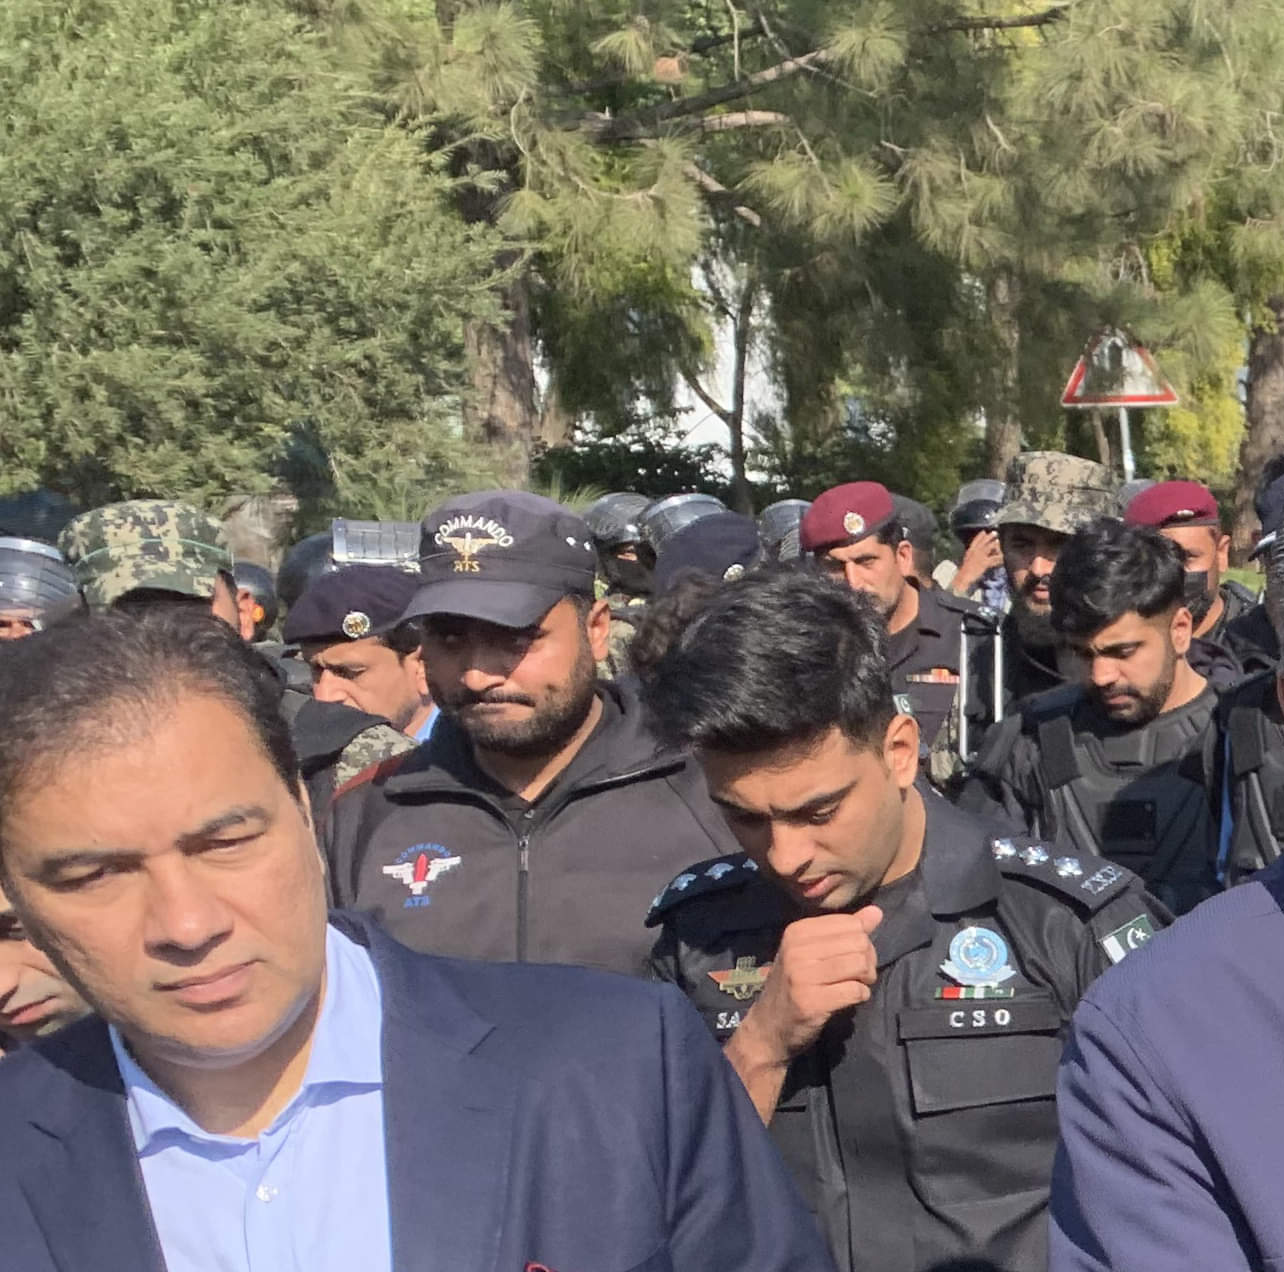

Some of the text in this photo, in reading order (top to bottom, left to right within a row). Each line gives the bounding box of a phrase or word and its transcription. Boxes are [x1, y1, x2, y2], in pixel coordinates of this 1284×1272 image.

[434, 514, 514, 547] COMMANDO
[453, 561, 480, 573] ATS
[716, 1011, 741, 1029] SA
